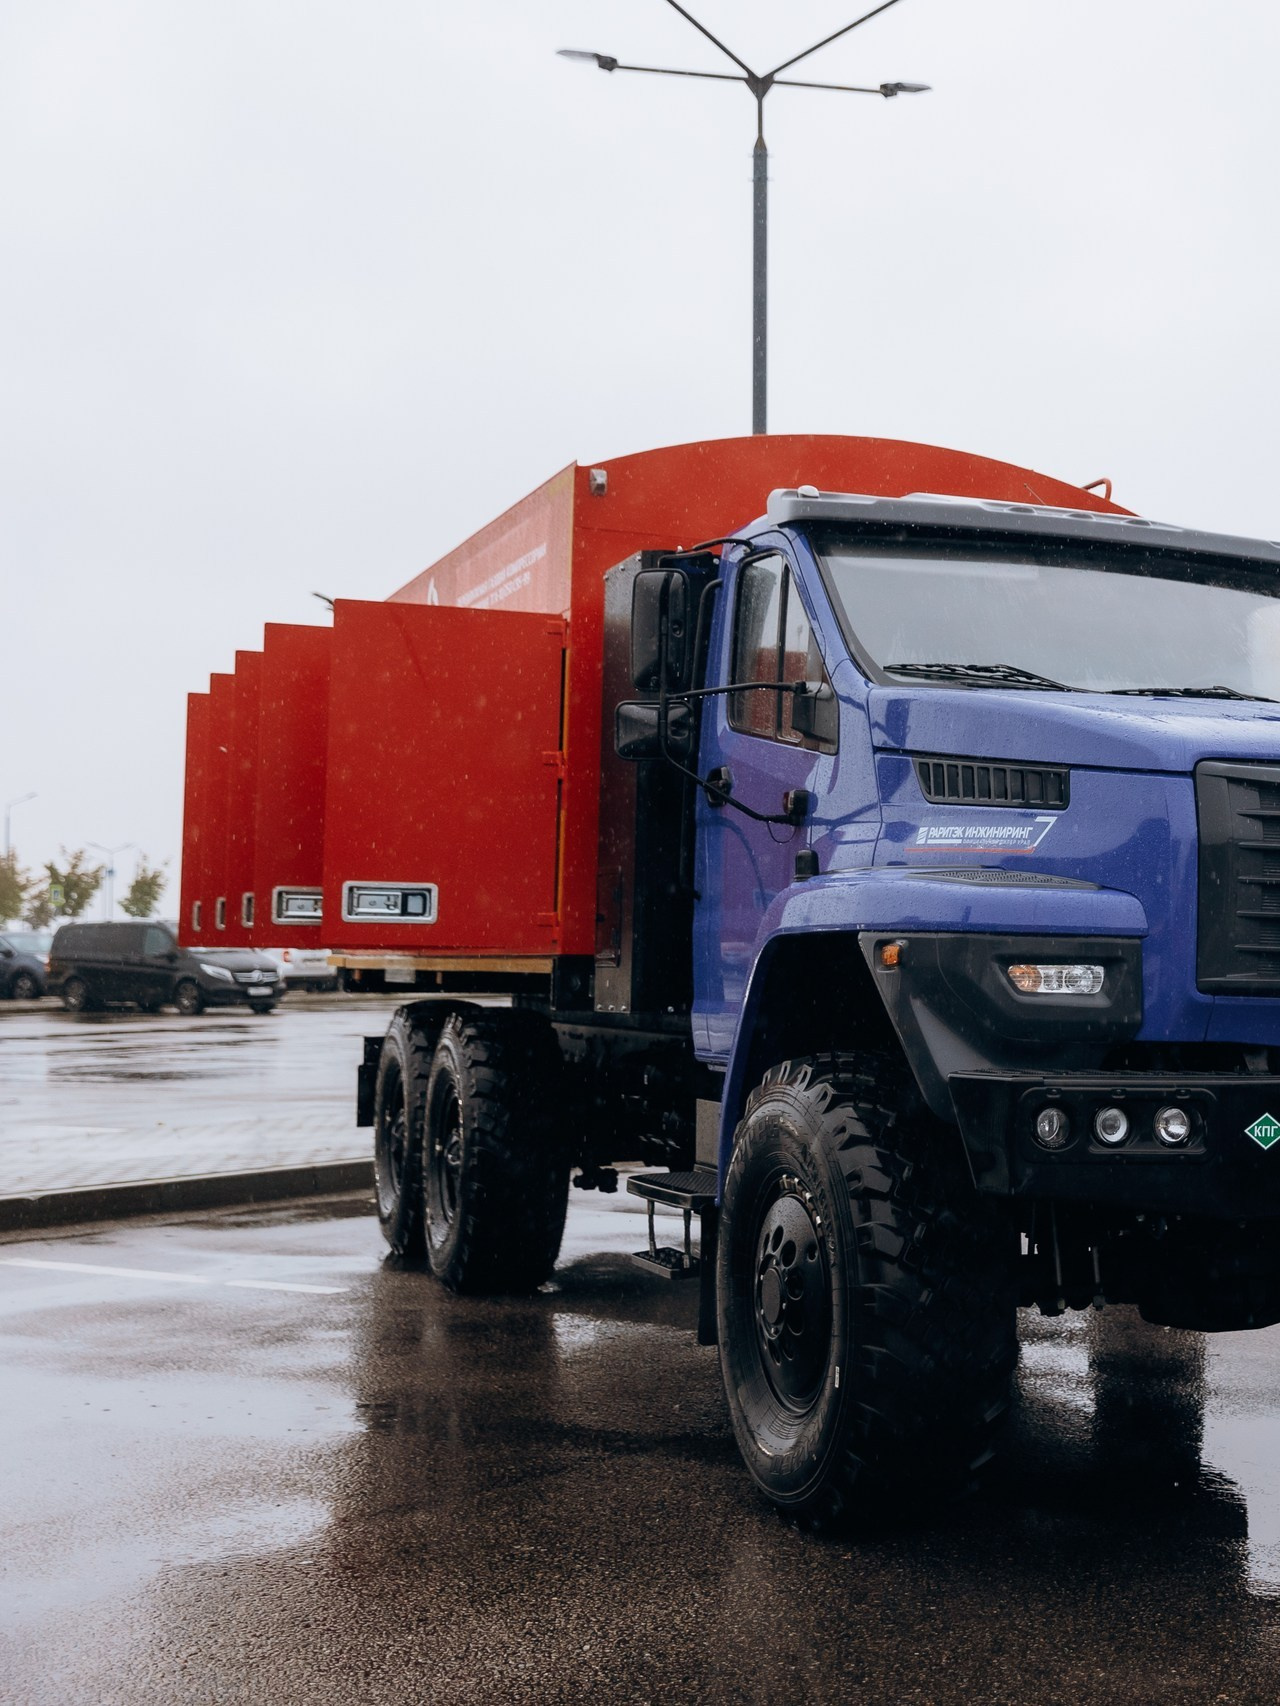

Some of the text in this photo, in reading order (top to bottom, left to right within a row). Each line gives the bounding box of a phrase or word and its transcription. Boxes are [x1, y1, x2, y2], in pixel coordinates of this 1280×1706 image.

[928, 826, 1033, 839] РАРИТЭК ИНЖИНИРИНГ
[1254, 1125, 1279, 1138] КПГ
